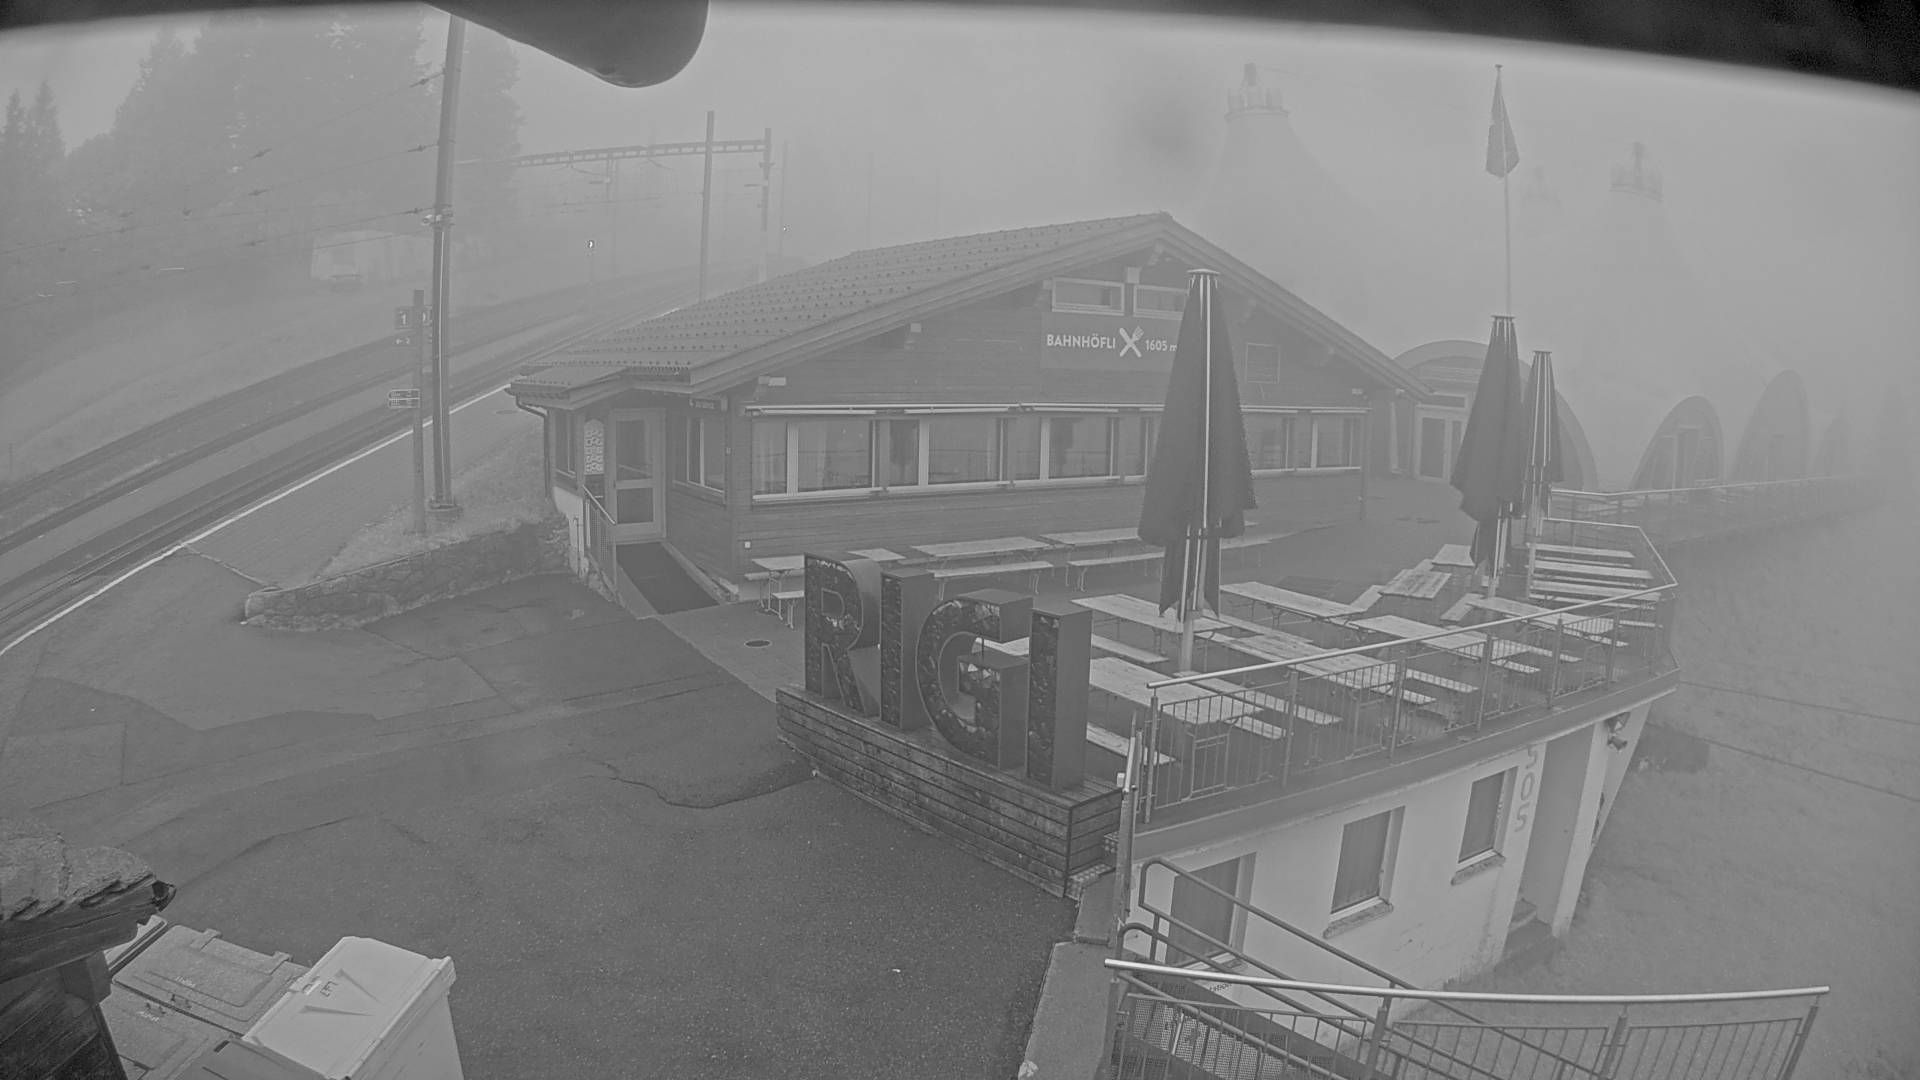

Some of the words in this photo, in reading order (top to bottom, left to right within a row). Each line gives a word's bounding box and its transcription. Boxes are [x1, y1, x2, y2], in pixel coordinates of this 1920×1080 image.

[1046, 333, 1116, 350] BAHNHÖFLI
[1145, 339, 1168, 352] 1605
[804, 553, 1091, 792] RIGI
